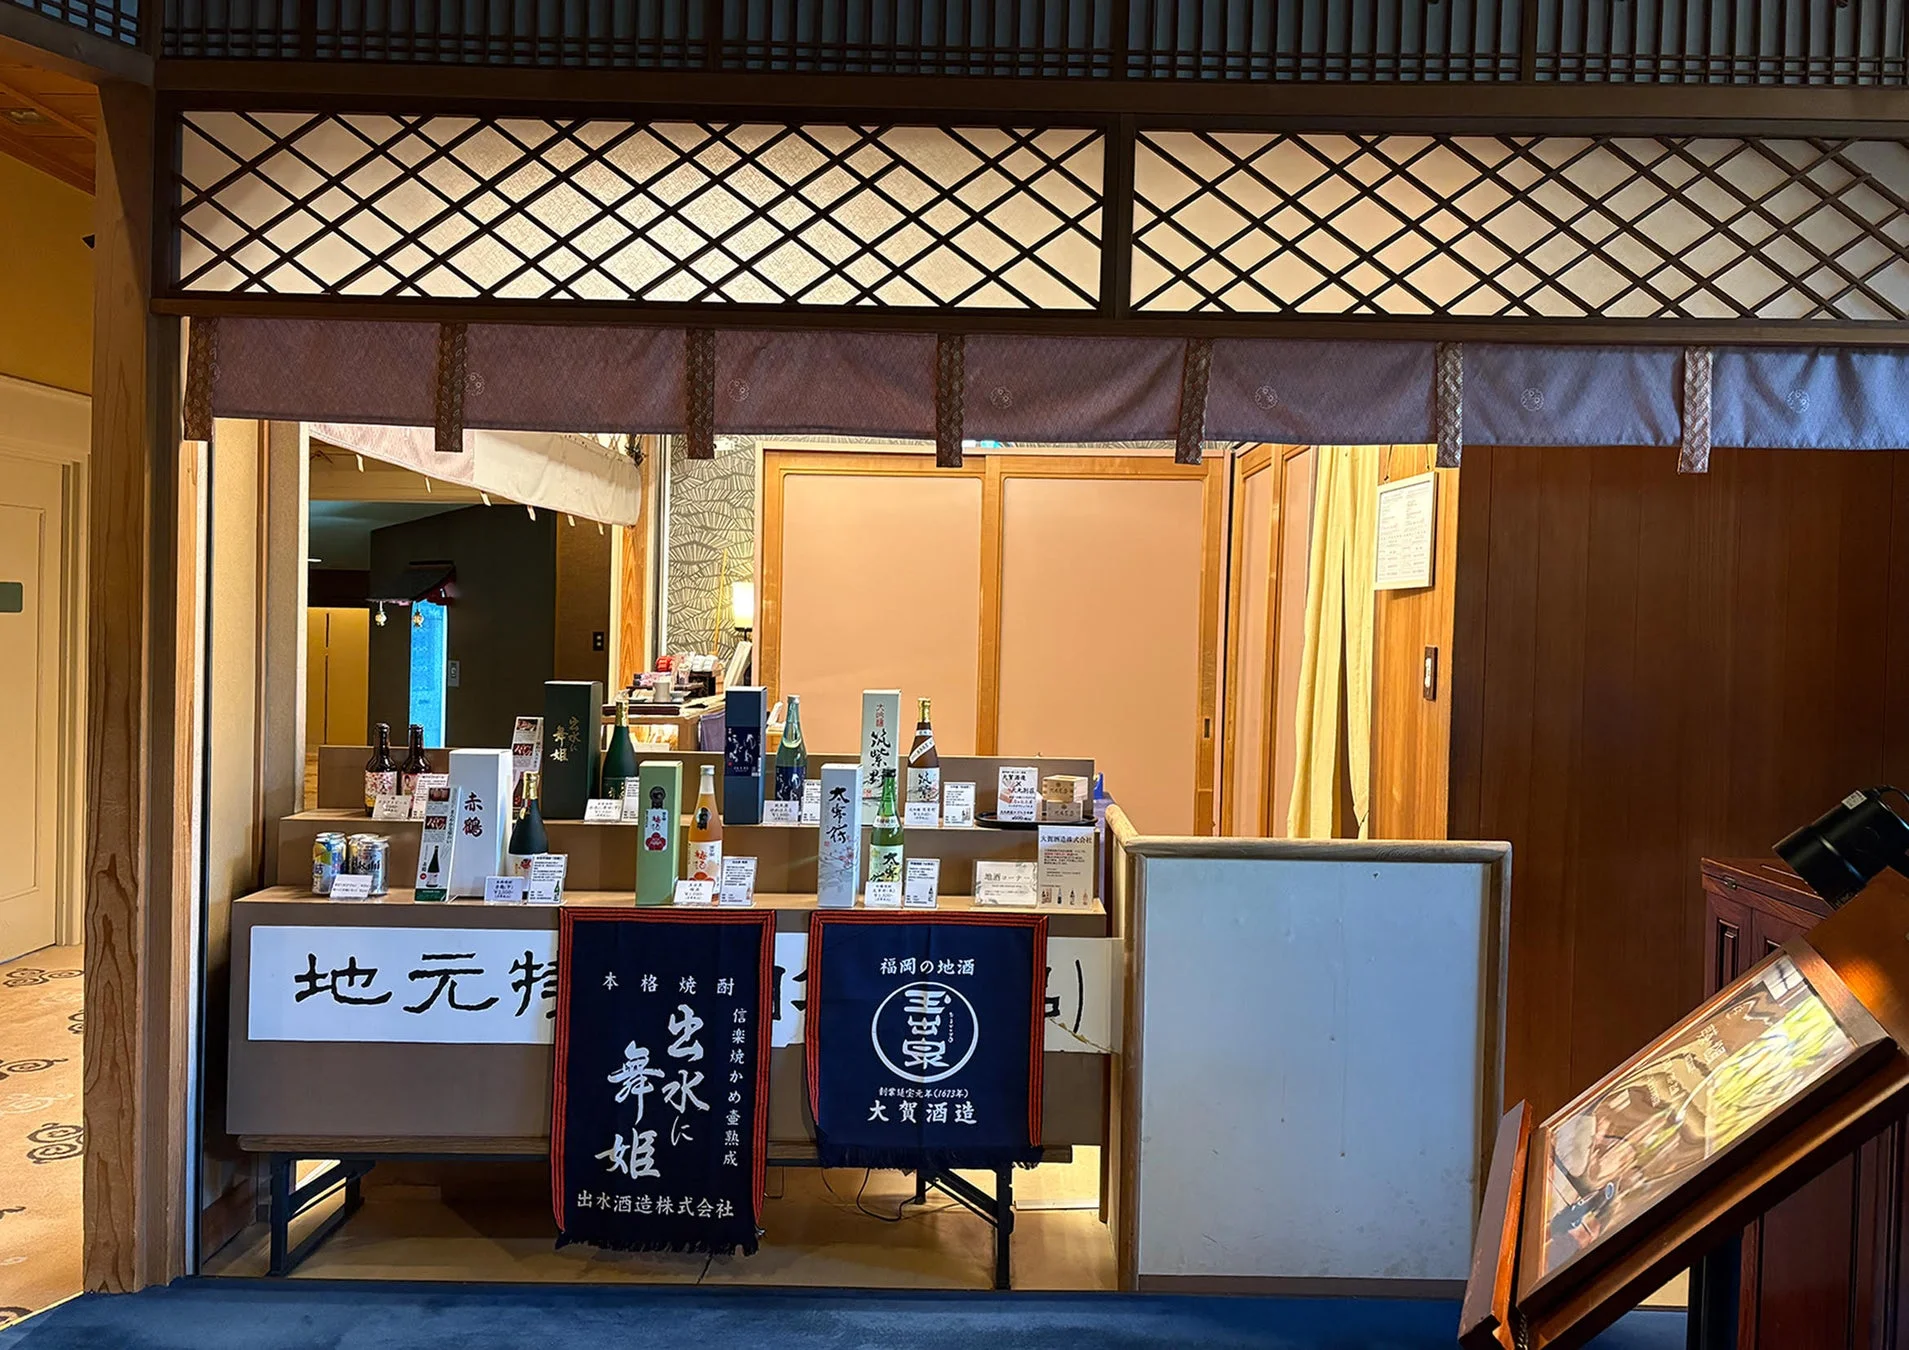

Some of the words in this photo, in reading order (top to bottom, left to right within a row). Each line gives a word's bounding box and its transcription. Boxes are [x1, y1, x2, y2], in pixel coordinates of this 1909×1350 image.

[463, 791, 484, 838] 赤鶴
[880, 957, 976, 976] 福岡の地酒
[602, 971, 736, 997] 本格焼酎
[661, 1004, 711, 1146] 出水に
[595, 1040, 666, 1181] 舞姫
[867, 1099, 978, 1125] 大賀酒造
[577, 1190, 735, 1219] 出水酒造株式会社
